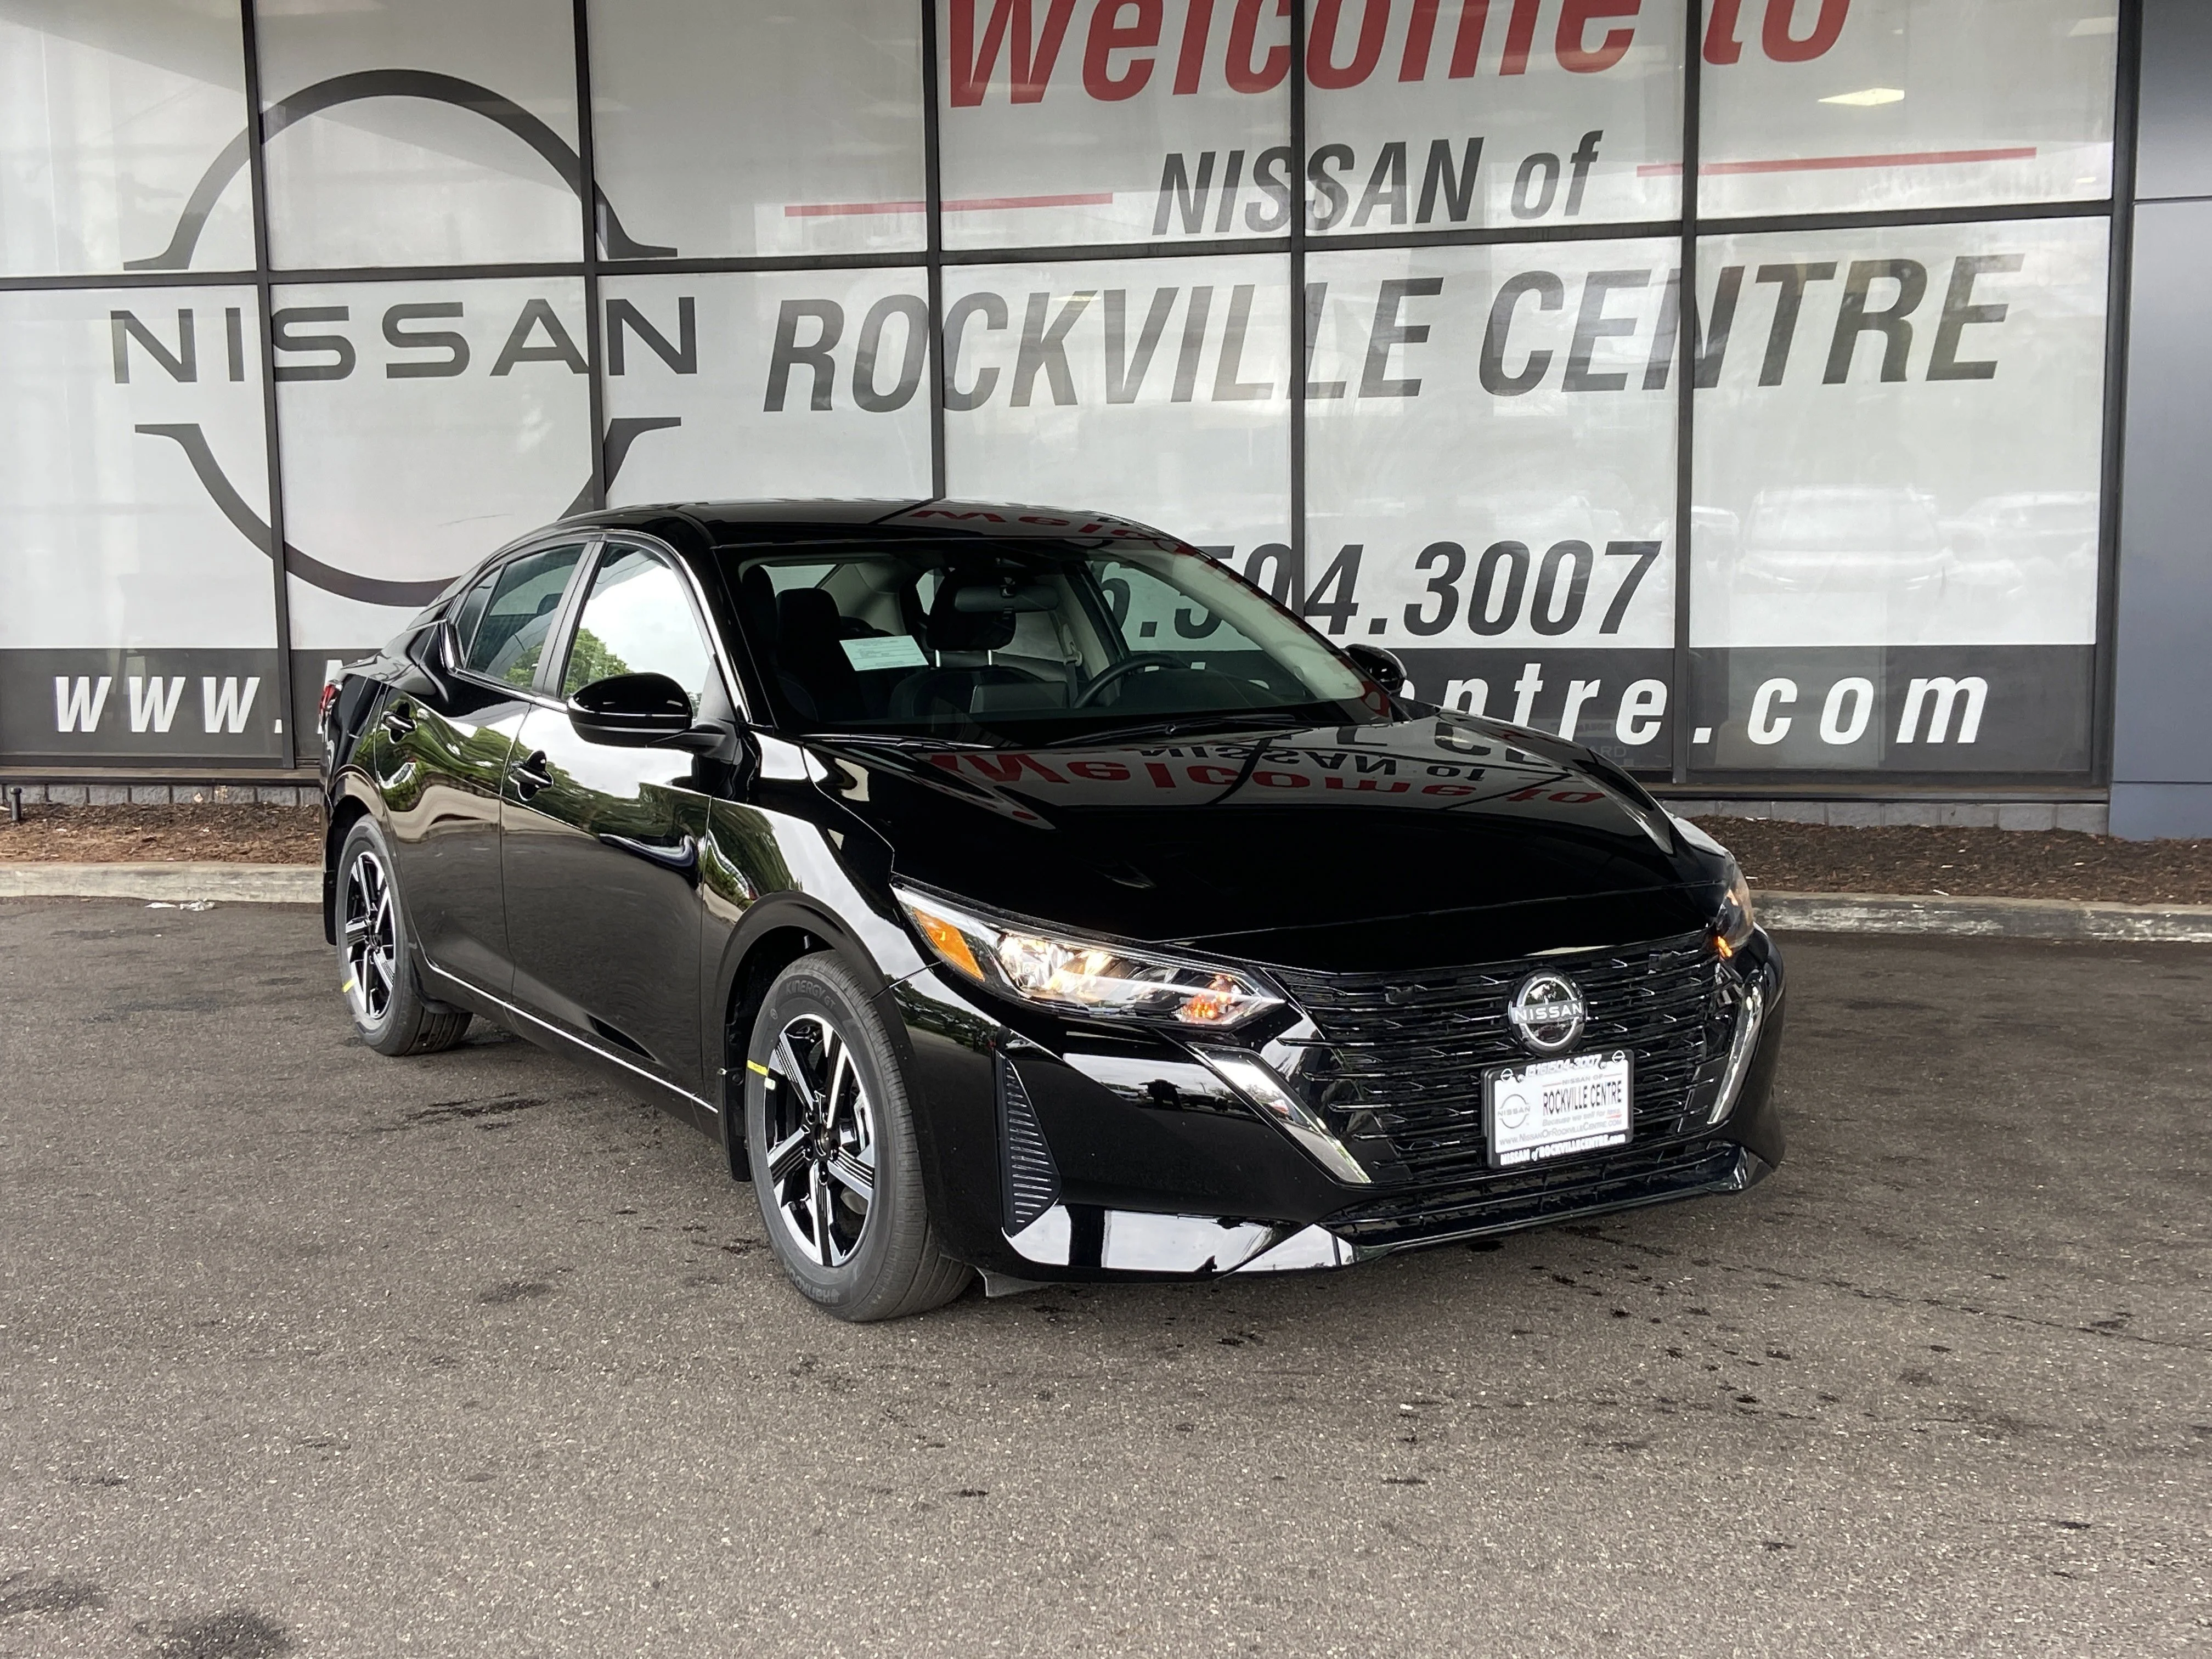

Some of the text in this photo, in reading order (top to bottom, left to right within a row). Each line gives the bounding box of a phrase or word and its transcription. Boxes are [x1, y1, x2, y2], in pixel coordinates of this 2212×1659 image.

[949, 0, 1636, 108] Welcome
[1152, 130, 1603, 236] NISSAN of
[110, 296, 698, 384] NISSAN
[763, 253, 2024, 413] ROCKVILLE CENTRE
[1514, 1002, 1583, 1022] NISSAN
[1542, 1079, 1622, 1116] ROCKVILLE CENTRE
[1562, 1076, 1591, 1085] NISSAN
[1497, 1105, 1531, 1117] NISSAN
[1500, 1148, 1530, 1166] NISSAN
